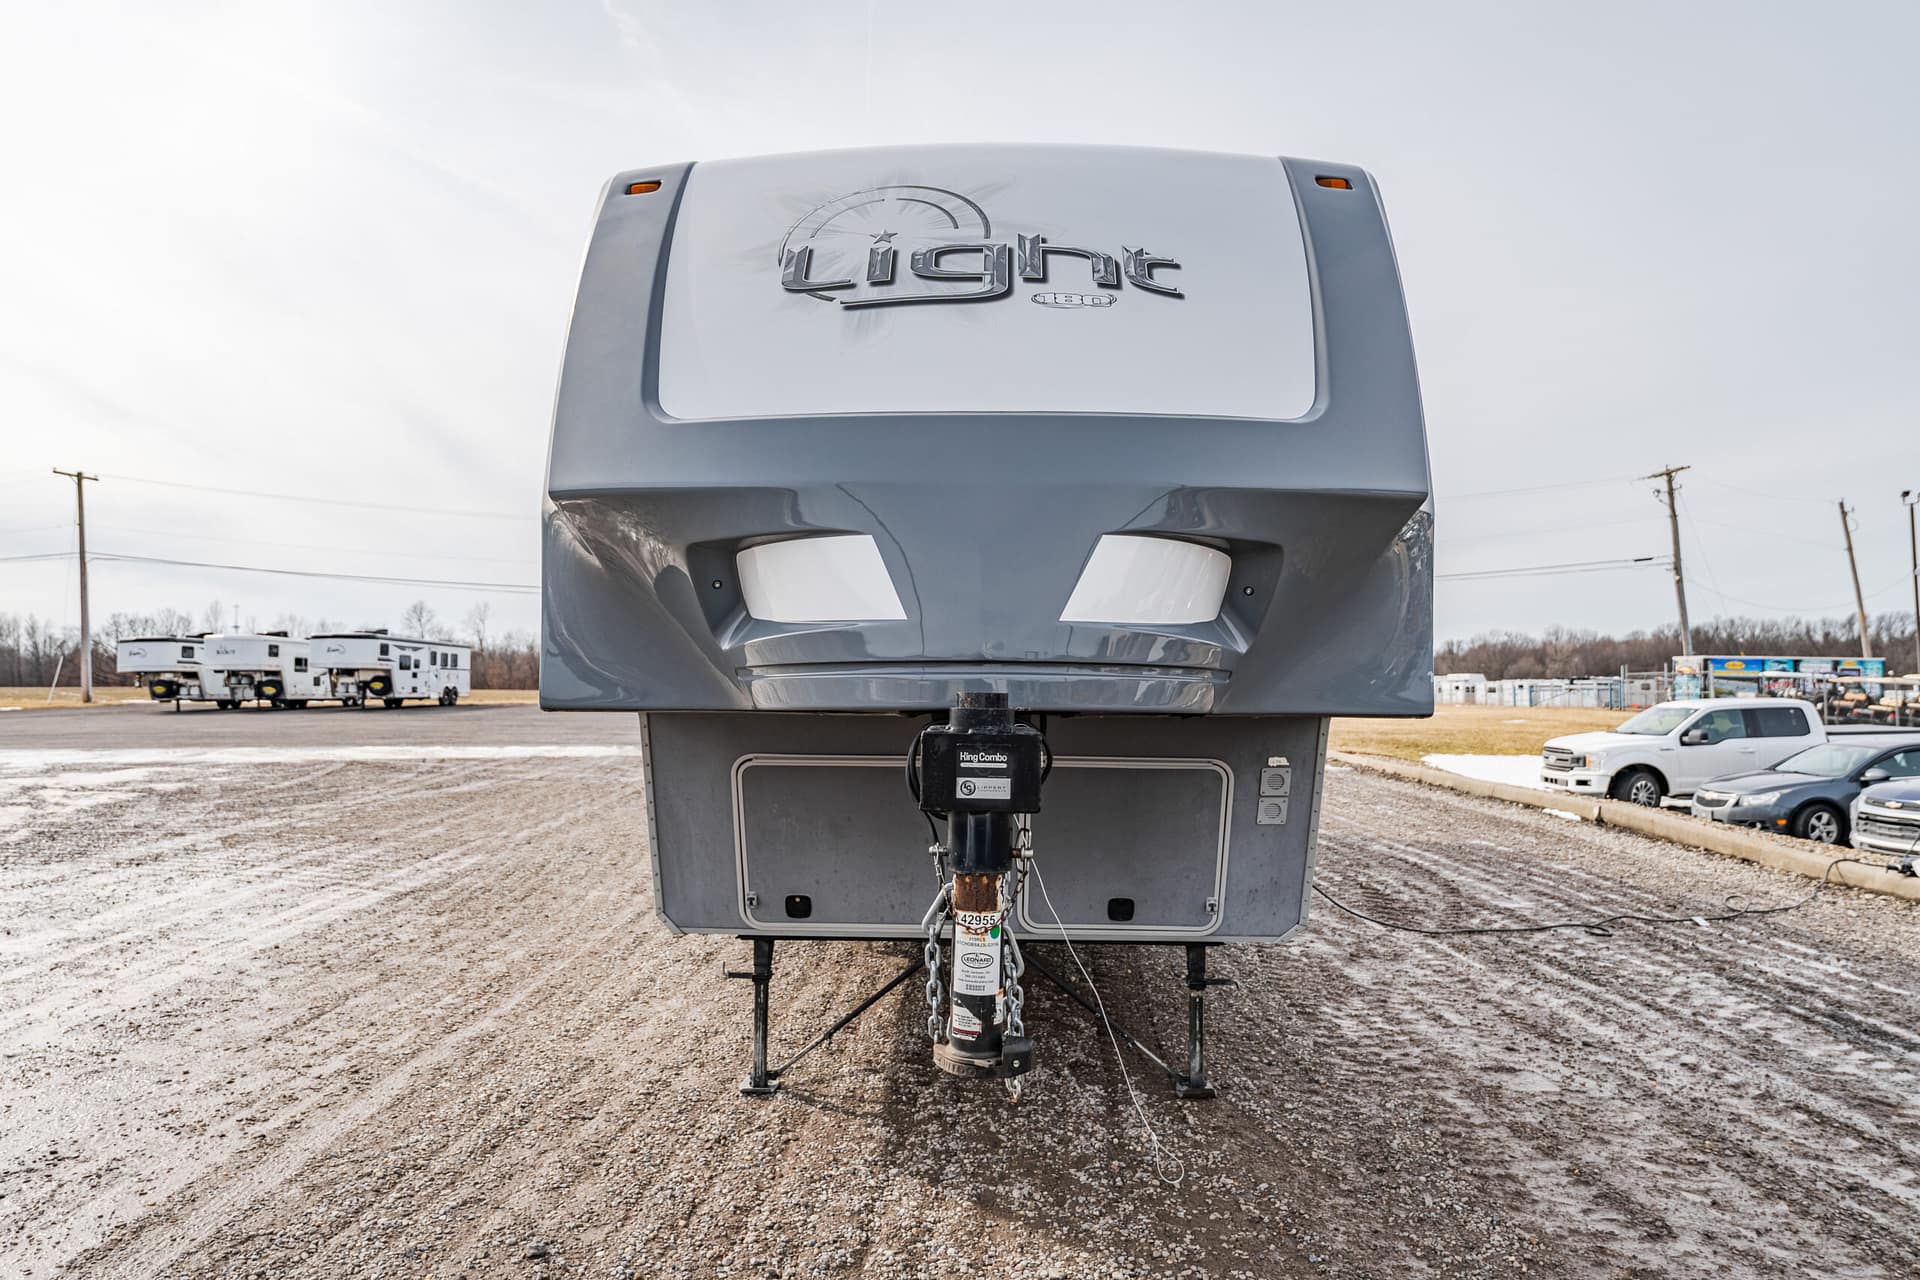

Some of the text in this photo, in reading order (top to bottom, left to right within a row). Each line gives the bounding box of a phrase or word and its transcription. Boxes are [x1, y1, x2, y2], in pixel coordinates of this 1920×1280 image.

[780, 231, 1183, 309] Light
[960, 751, 1008, 763] King Combo
[961, 914, 996, 926] 42955
